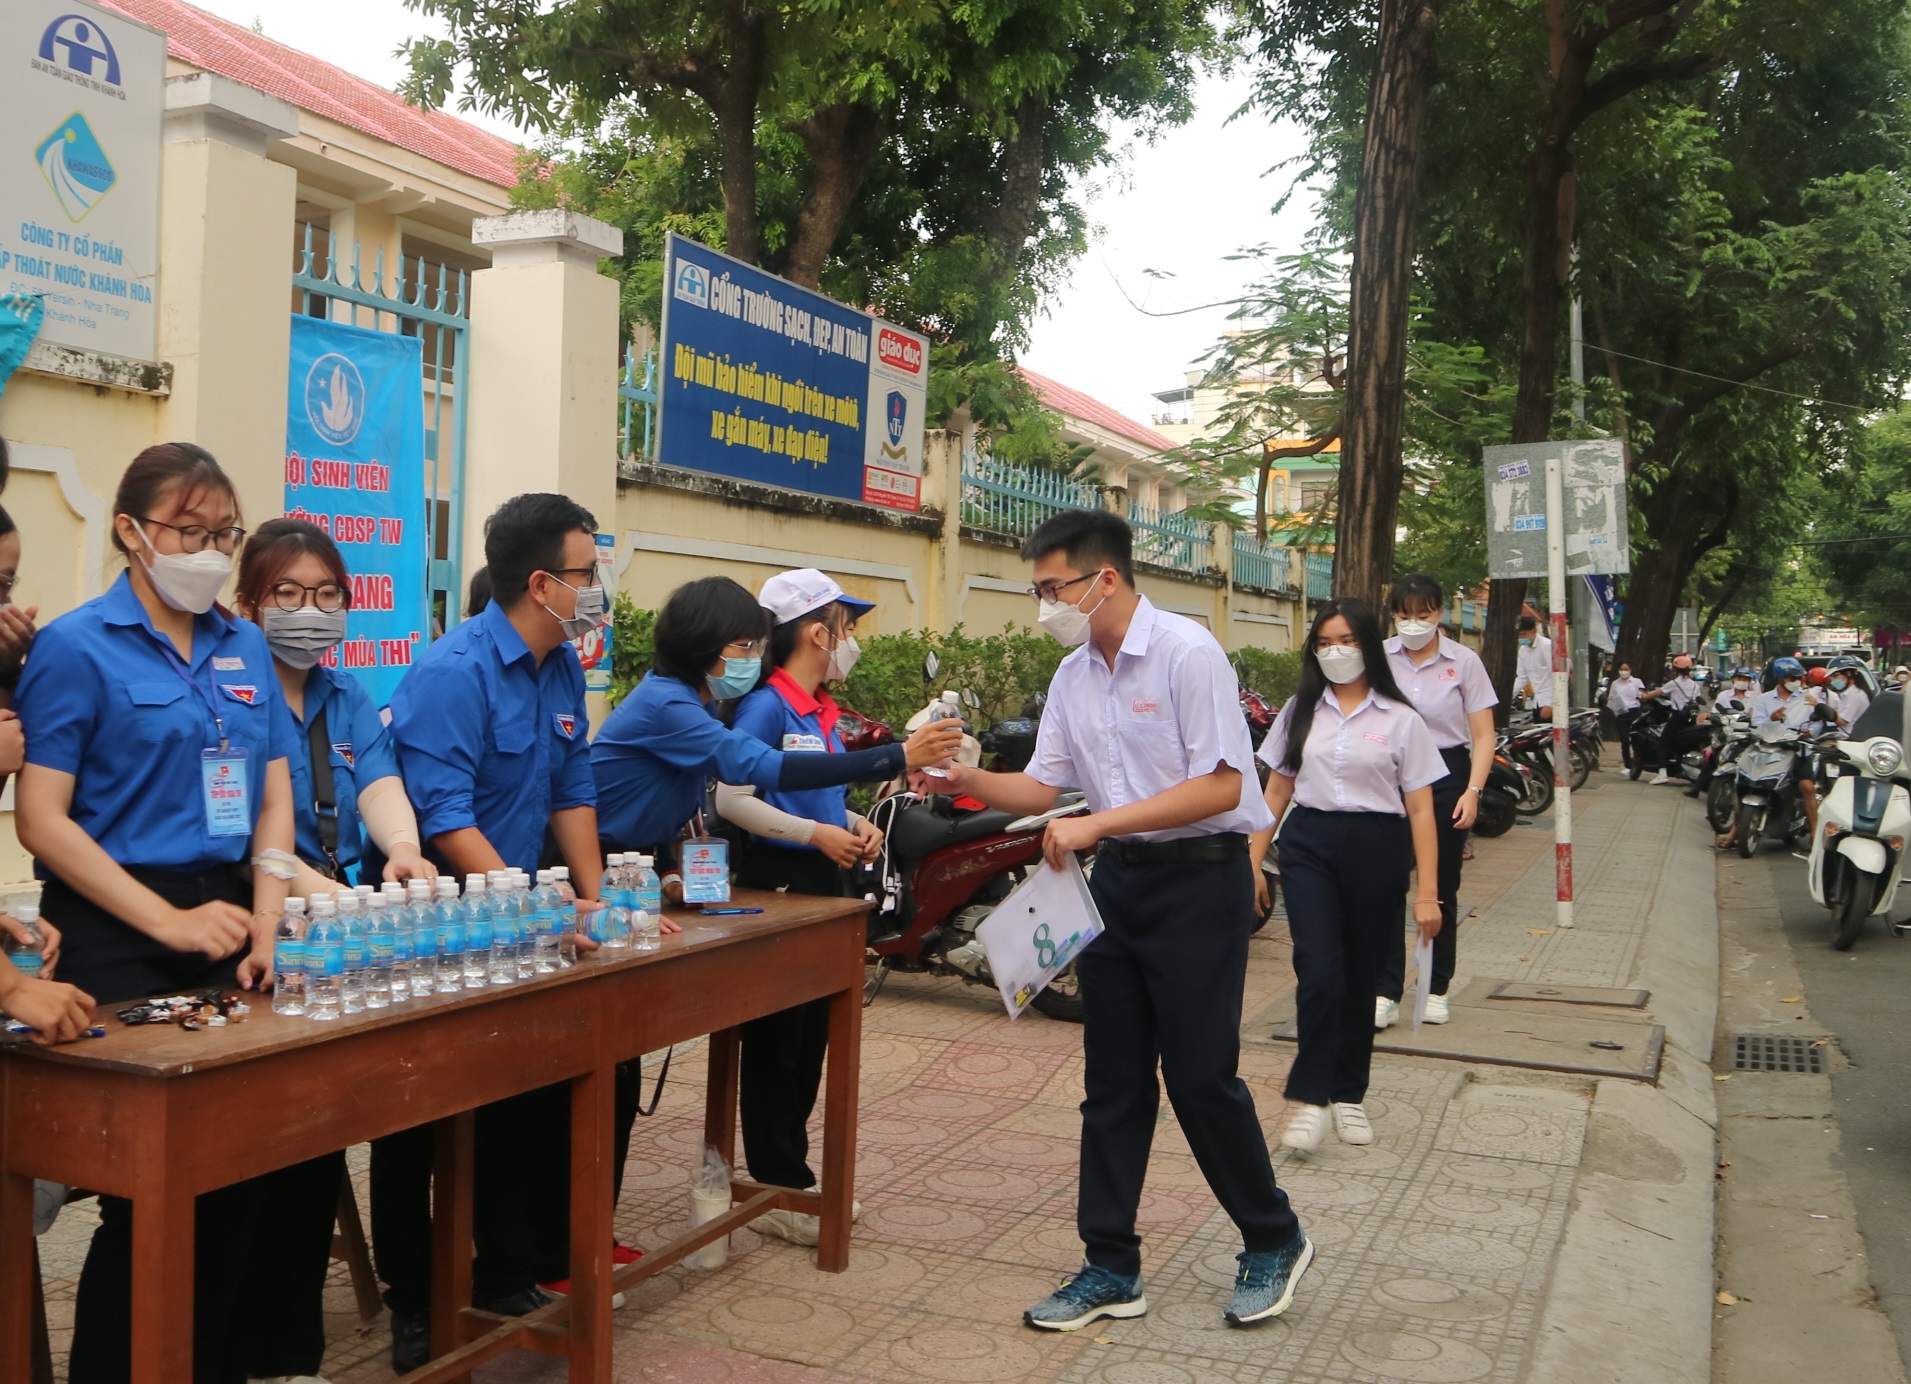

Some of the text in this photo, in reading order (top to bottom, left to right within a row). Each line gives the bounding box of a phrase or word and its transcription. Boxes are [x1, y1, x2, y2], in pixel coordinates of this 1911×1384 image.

[21, 221, 123, 266] CÔNG TY CỔ PHẦN
[14, 253, 52, 280] THOÁT
[54, 263, 86, 289] NƯỚC
[89, 272, 127, 299] KHÁNH
[130, 280, 152, 304] HÒA
[46, 307, 97, 329] Khánh Hòa
[84, 299, 102, 313] Nha
[105, 303, 130, 321] Trang
[710, 271, 742, 320] CỔNG
[743, 289, 784, 334] TRƯỜNG
[784, 305, 812, 347] SẠCH,
[831, 323, 845, 356] AN
[845, 326, 868, 364] TOÀN
[880, 332, 903, 358] giáo
[903, 342, 921, 368] dục
[674, 342, 696, 389] Đội
[695, 351, 715, 388] mũ
[715, 353, 737, 394] bảo
[737, 361, 765, 402] hiểm
[764, 371, 782, 406] khi
[782, 379, 805, 414] ngồi
[804, 386, 824, 418] trên
[824, 394, 836, 421] xe
[711, 405, 830, 469] xe gắn máy, xe đạp điện!
[311, 458, 351, 489] SINH
[355, 459, 391, 492] VIÊN
[335, 514, 376, 544] CĐSP
[379, 518, 403, 544] TW
[344, 635, 376, 668] MÙA
